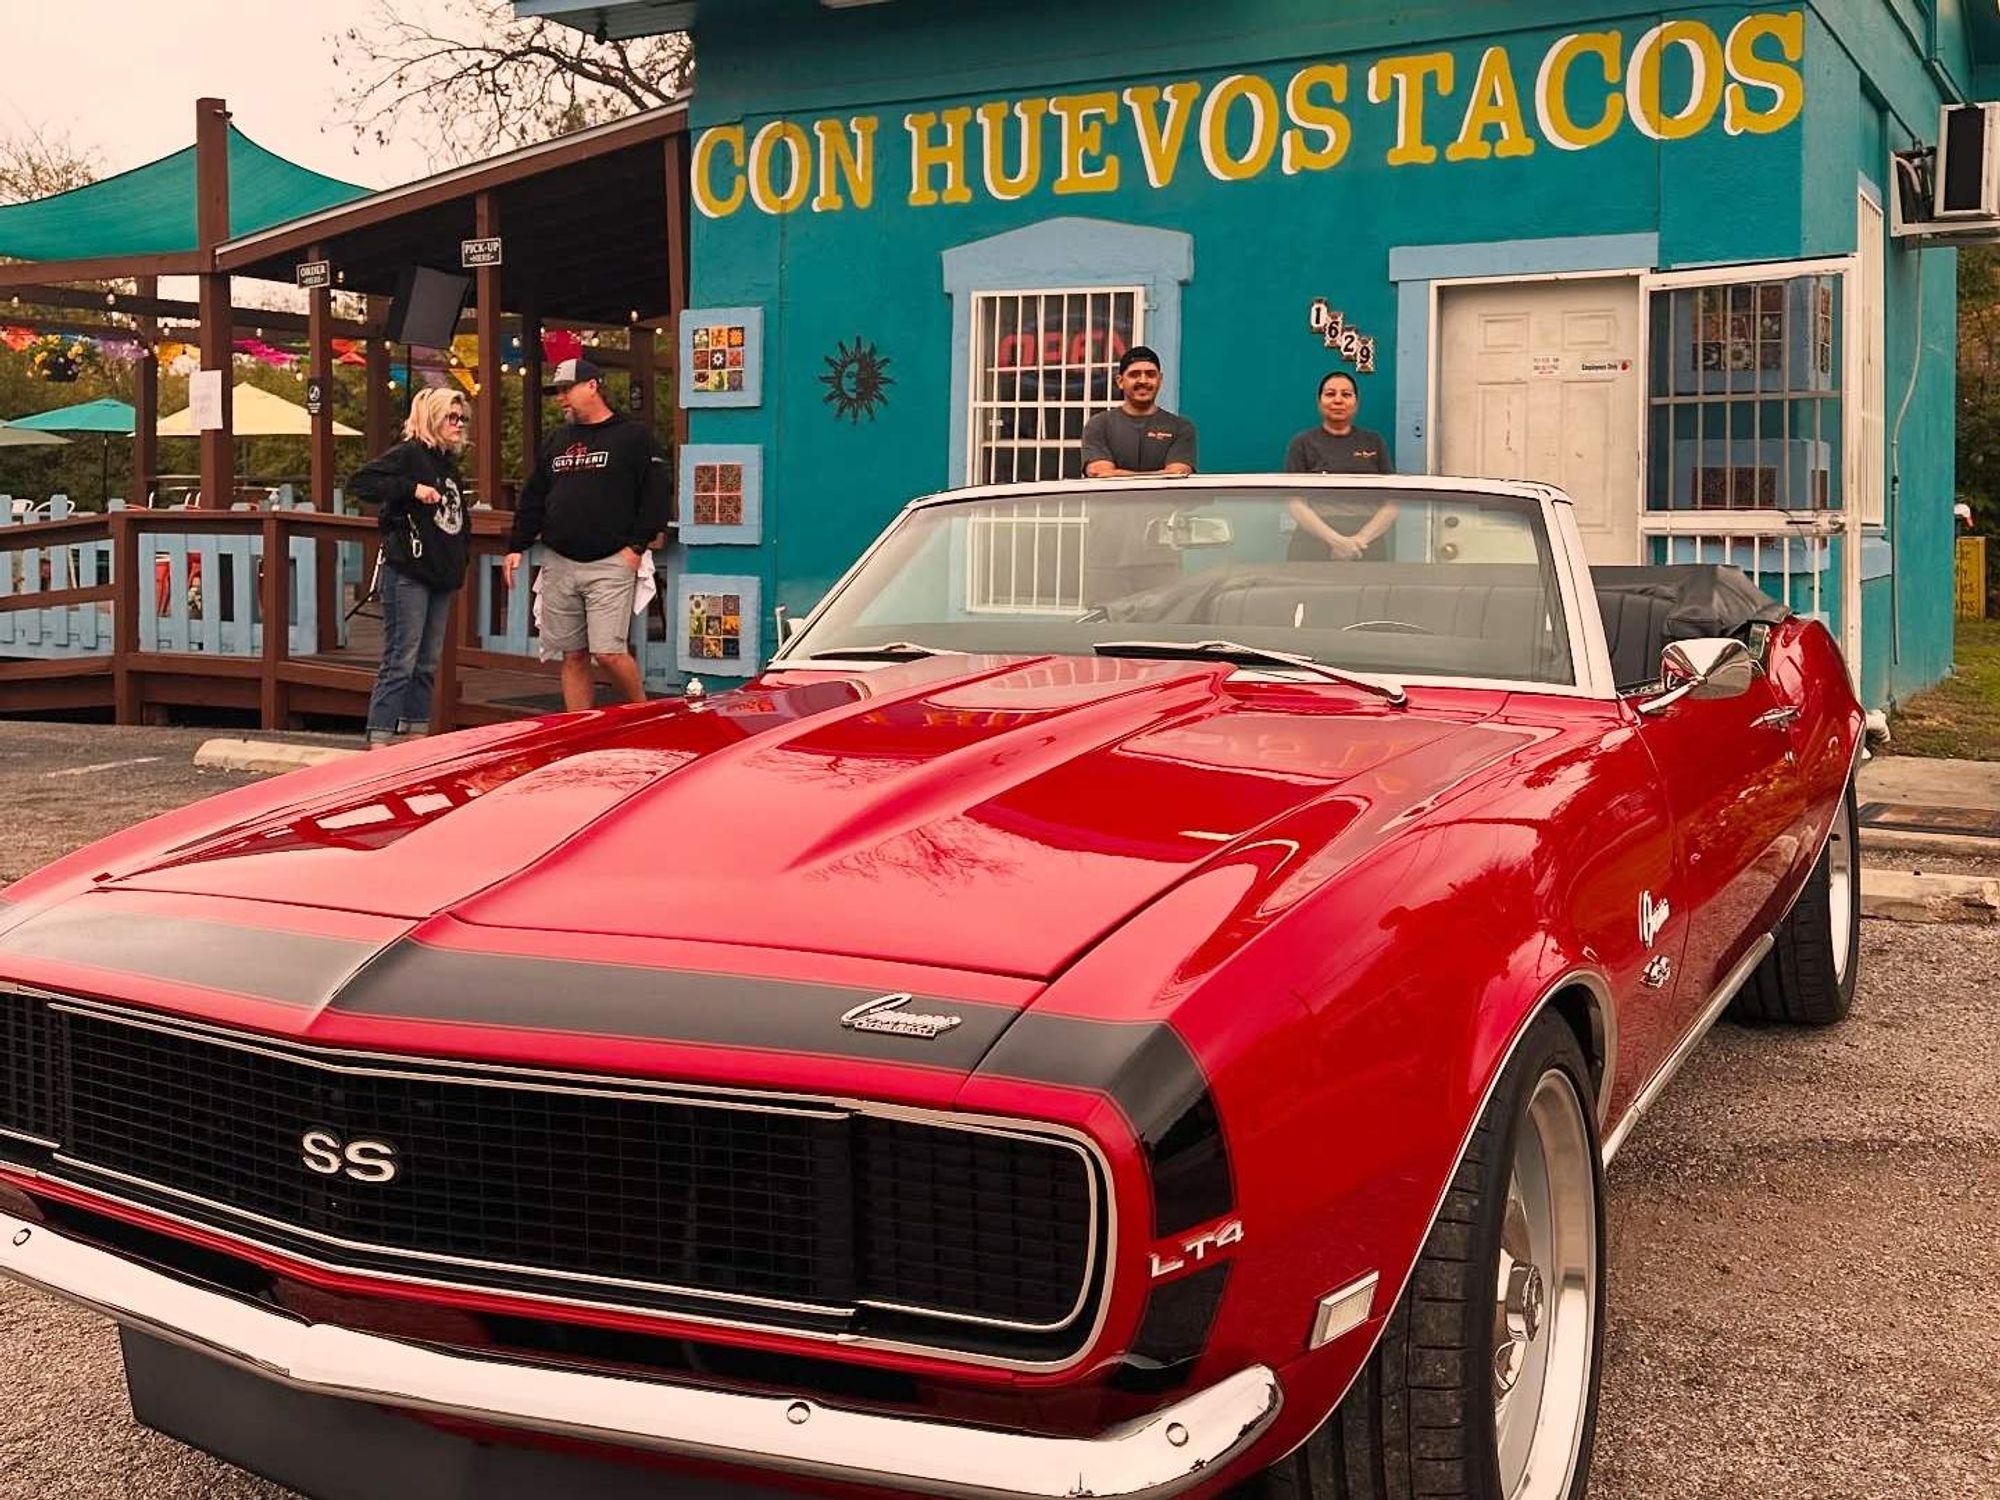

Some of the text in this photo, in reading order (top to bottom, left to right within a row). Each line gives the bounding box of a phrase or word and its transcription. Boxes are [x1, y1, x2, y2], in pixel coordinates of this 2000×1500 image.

[690, 11, 1804, 219] CON HUEVOS TACOS
[300, 264, 326, 277] ORDER
[465, 241, 500, 254] PICK-UP
[302, 1131, 396, 1182] SS
[1149, 1219, 1244, 1279] LT4
